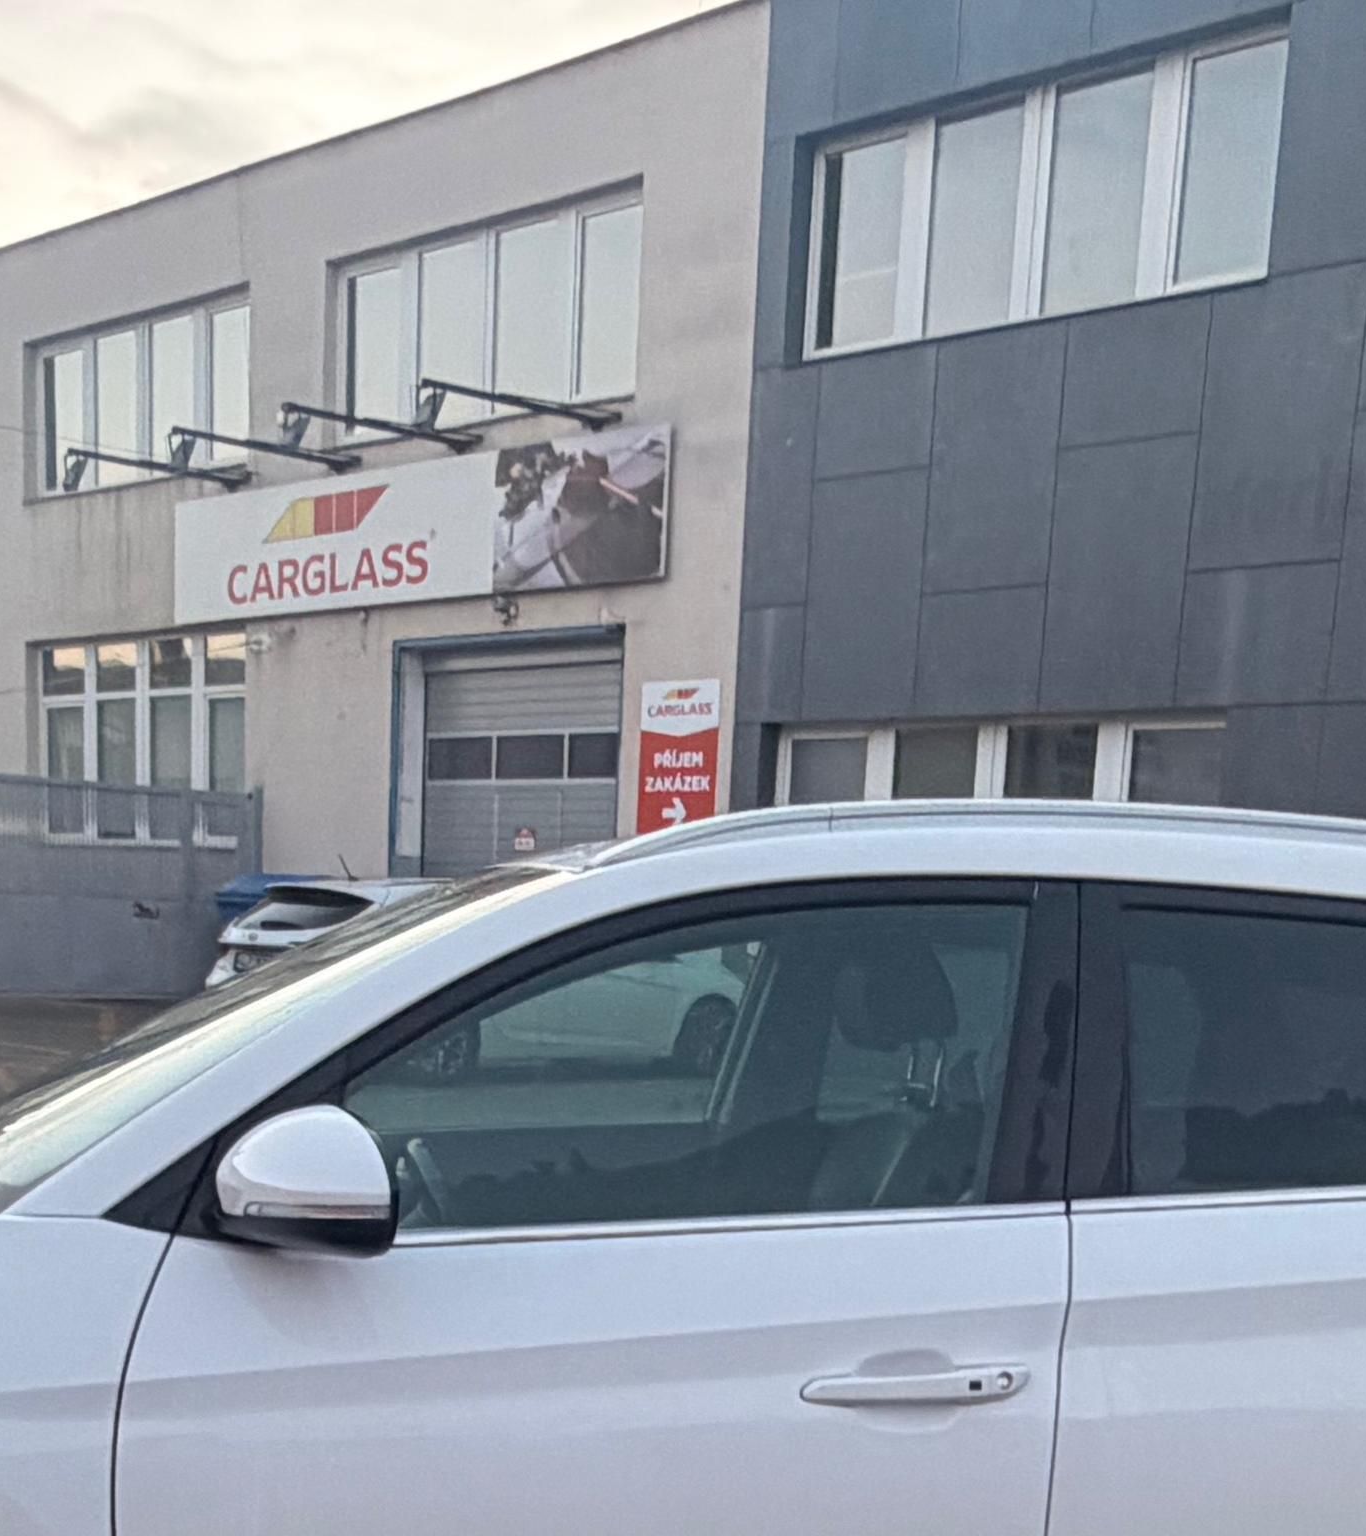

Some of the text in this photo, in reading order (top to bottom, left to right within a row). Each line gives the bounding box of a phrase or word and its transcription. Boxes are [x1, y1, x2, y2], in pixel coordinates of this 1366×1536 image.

[227, 540, 429, 605] CARGLASS
[647, 702, 712, 718] CARGLASS
[654, 748, 703, 768] PŘÍJEM
[645, 773, 710, 792] ZAKÁZEK
